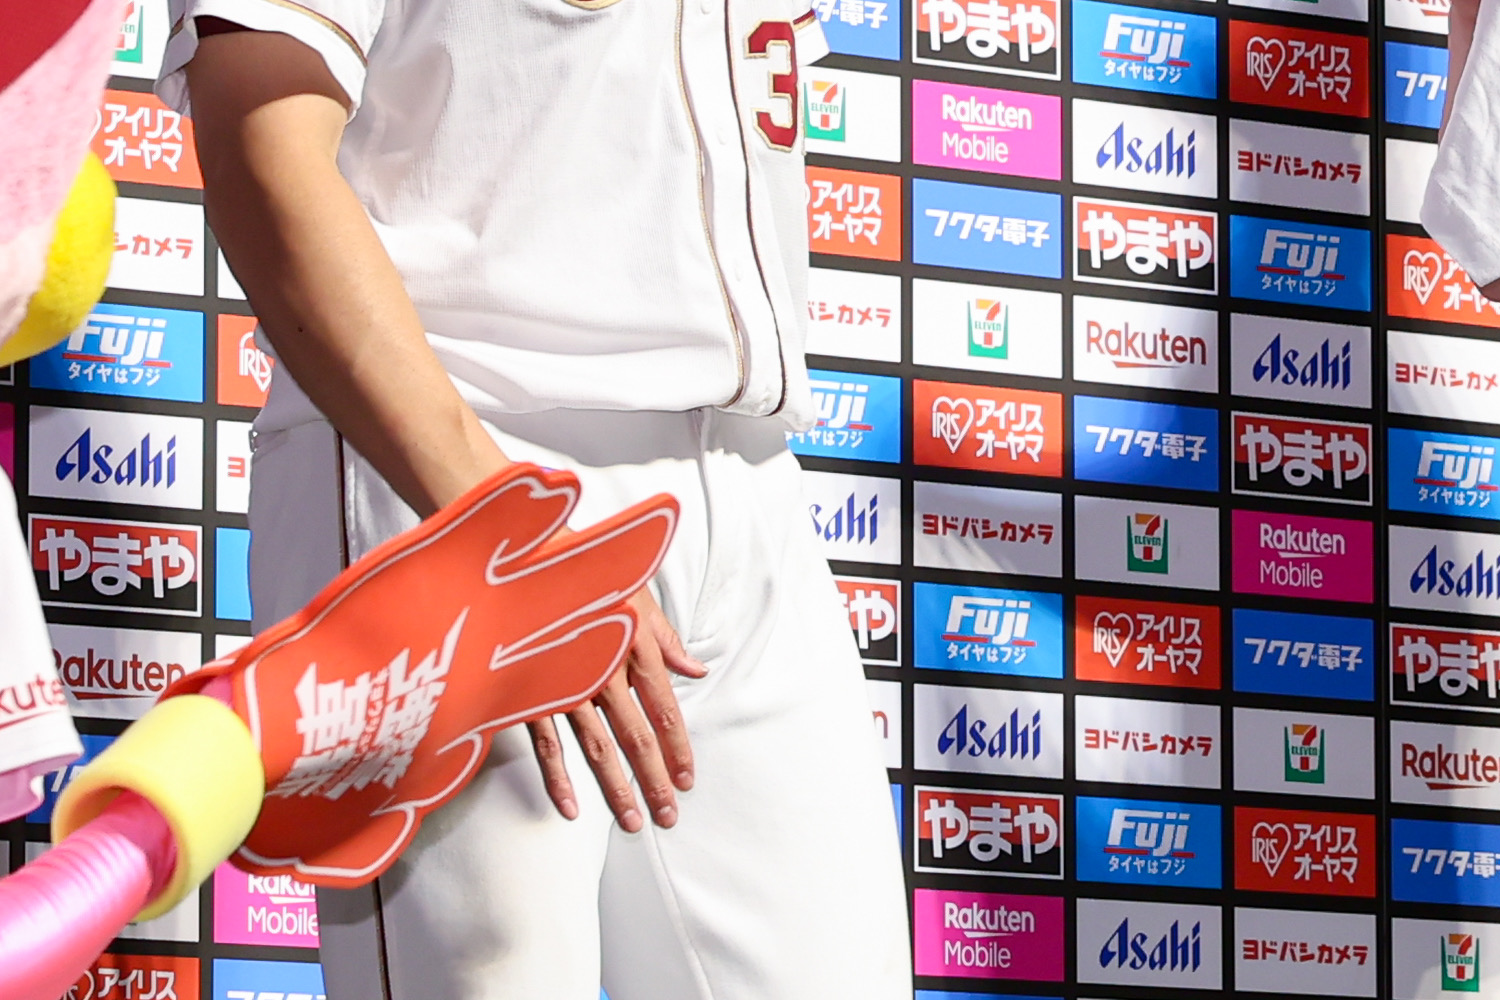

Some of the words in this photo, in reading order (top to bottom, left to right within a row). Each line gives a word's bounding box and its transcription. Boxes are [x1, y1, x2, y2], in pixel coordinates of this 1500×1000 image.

[1101, 14, 1187, 63] Fuji
[1287, 39, 1351, 74] アイリス
[942, 93, 1032, 129] Rakuten
[105, 139, 182, 171] オーヤマ
[941, 130, 1009, 163] Mobile
[1097, 125, 1195, 177] Asahi
[1239, 152, 1361, 183] ヨドバシカメラ
[813, 180, 881, 217] アイリス
[813, 212, 880, 246] オーヤマ
[1081, 208, 1214, 282] やまや
[1258, 229, 1341, 277] Fuji
[1085, 318, 1205, 365] Rakuten
[1254, 336, 1350, 388] Asahi
[976, 397, 1044, 432] アイリス
[57, 430, 175, 485] Asahi
[976, 428, 1044, 462] オーヤマ
[1240, 422, 1367, 493] やまや
[1414, 441, 1494, 488] Fuji
[1416, 486, 1489, 508] タイヤはフジ
[923, 515, 1053, 544] ヨドバシカメラ
[1262, 521, 1346, 554] Rakuten
[38, 526, 197, 603] やまや
[1261, 557, 1324, 588] Mobile
[942, 596, 1030, 643] Fuji
[944, 642, 1025, 664] タイヤはフジ
[938, 706, 1040, 758] Asahi
[1086, 730, 1211, 757] ヨドバシカメラ
[922, 797, 1059, 866] やまや
[1106, 809, 1191, 855] Fuji
[1293, 822, 1356, 854] アイリス
[1293, 852, 1356, 883] オーヤマ
[947, 901, 1036, 932] Rakuten
[947, 939, 1014, 969] Mobile
[1101, 920, 1200, 970] Asahi
[1244, 940, 1367, 965] ヨドバシカメラ
[98, 968, 176, 999] アイリス
